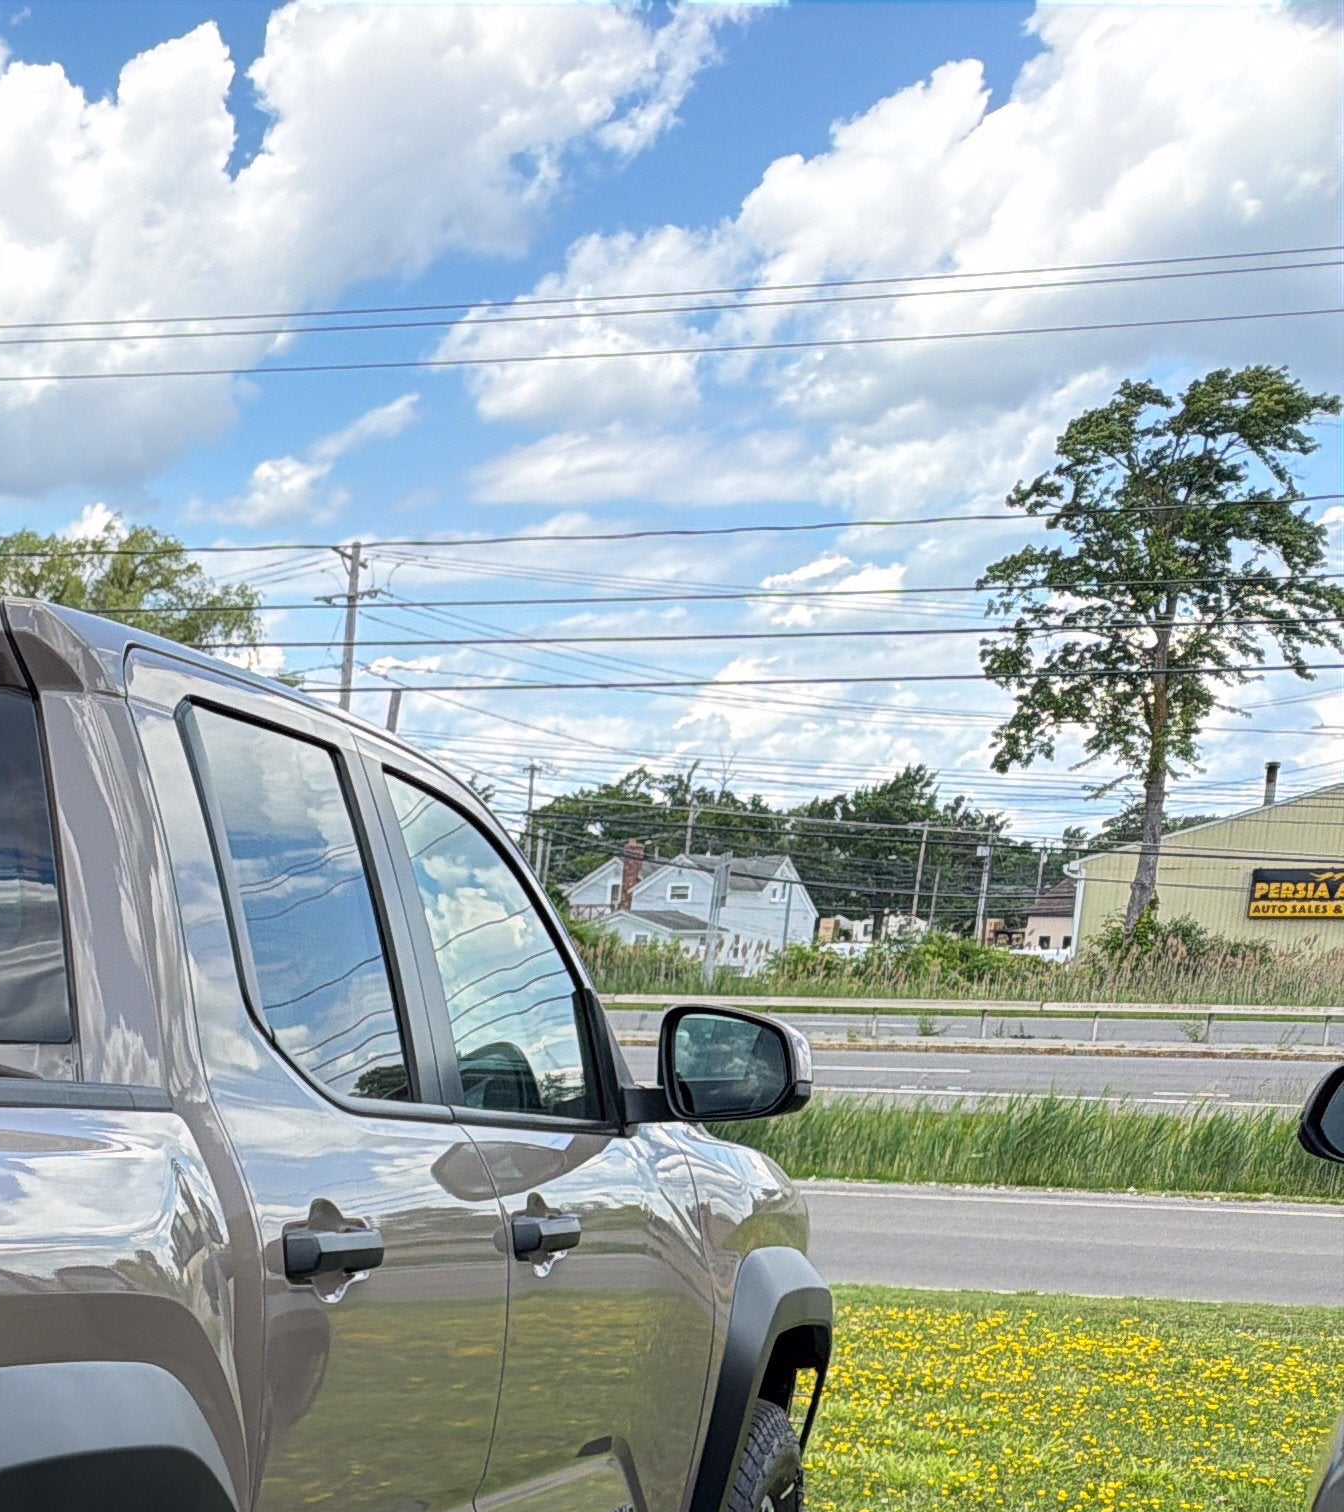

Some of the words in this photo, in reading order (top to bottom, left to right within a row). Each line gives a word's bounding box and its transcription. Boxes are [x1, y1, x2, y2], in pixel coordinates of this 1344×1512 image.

[1254, 882, 1330, 899] PERSIA
[1252, 904, 1287, 914] AUTO
[1290, 904, 1328, 914] SALES
[1332, 904, 1343, 914] &
